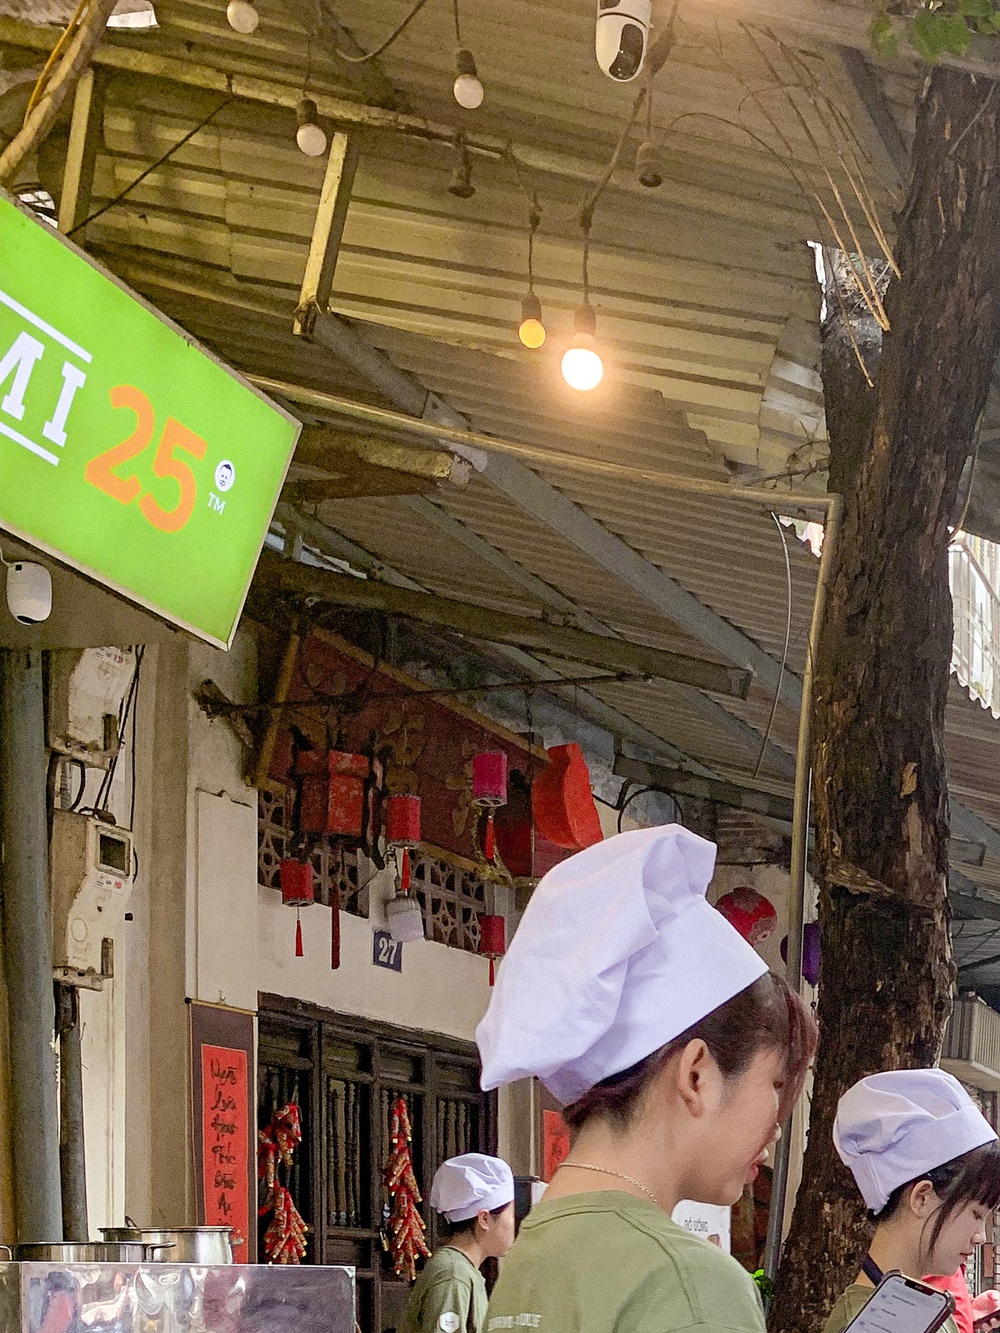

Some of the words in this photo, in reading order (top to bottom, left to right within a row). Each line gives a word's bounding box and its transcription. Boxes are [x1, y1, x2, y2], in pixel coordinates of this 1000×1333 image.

[85, 383, 208, 534] 25
[207, 491, 227, 515] TM
[378, 936, 398, 965] 27
